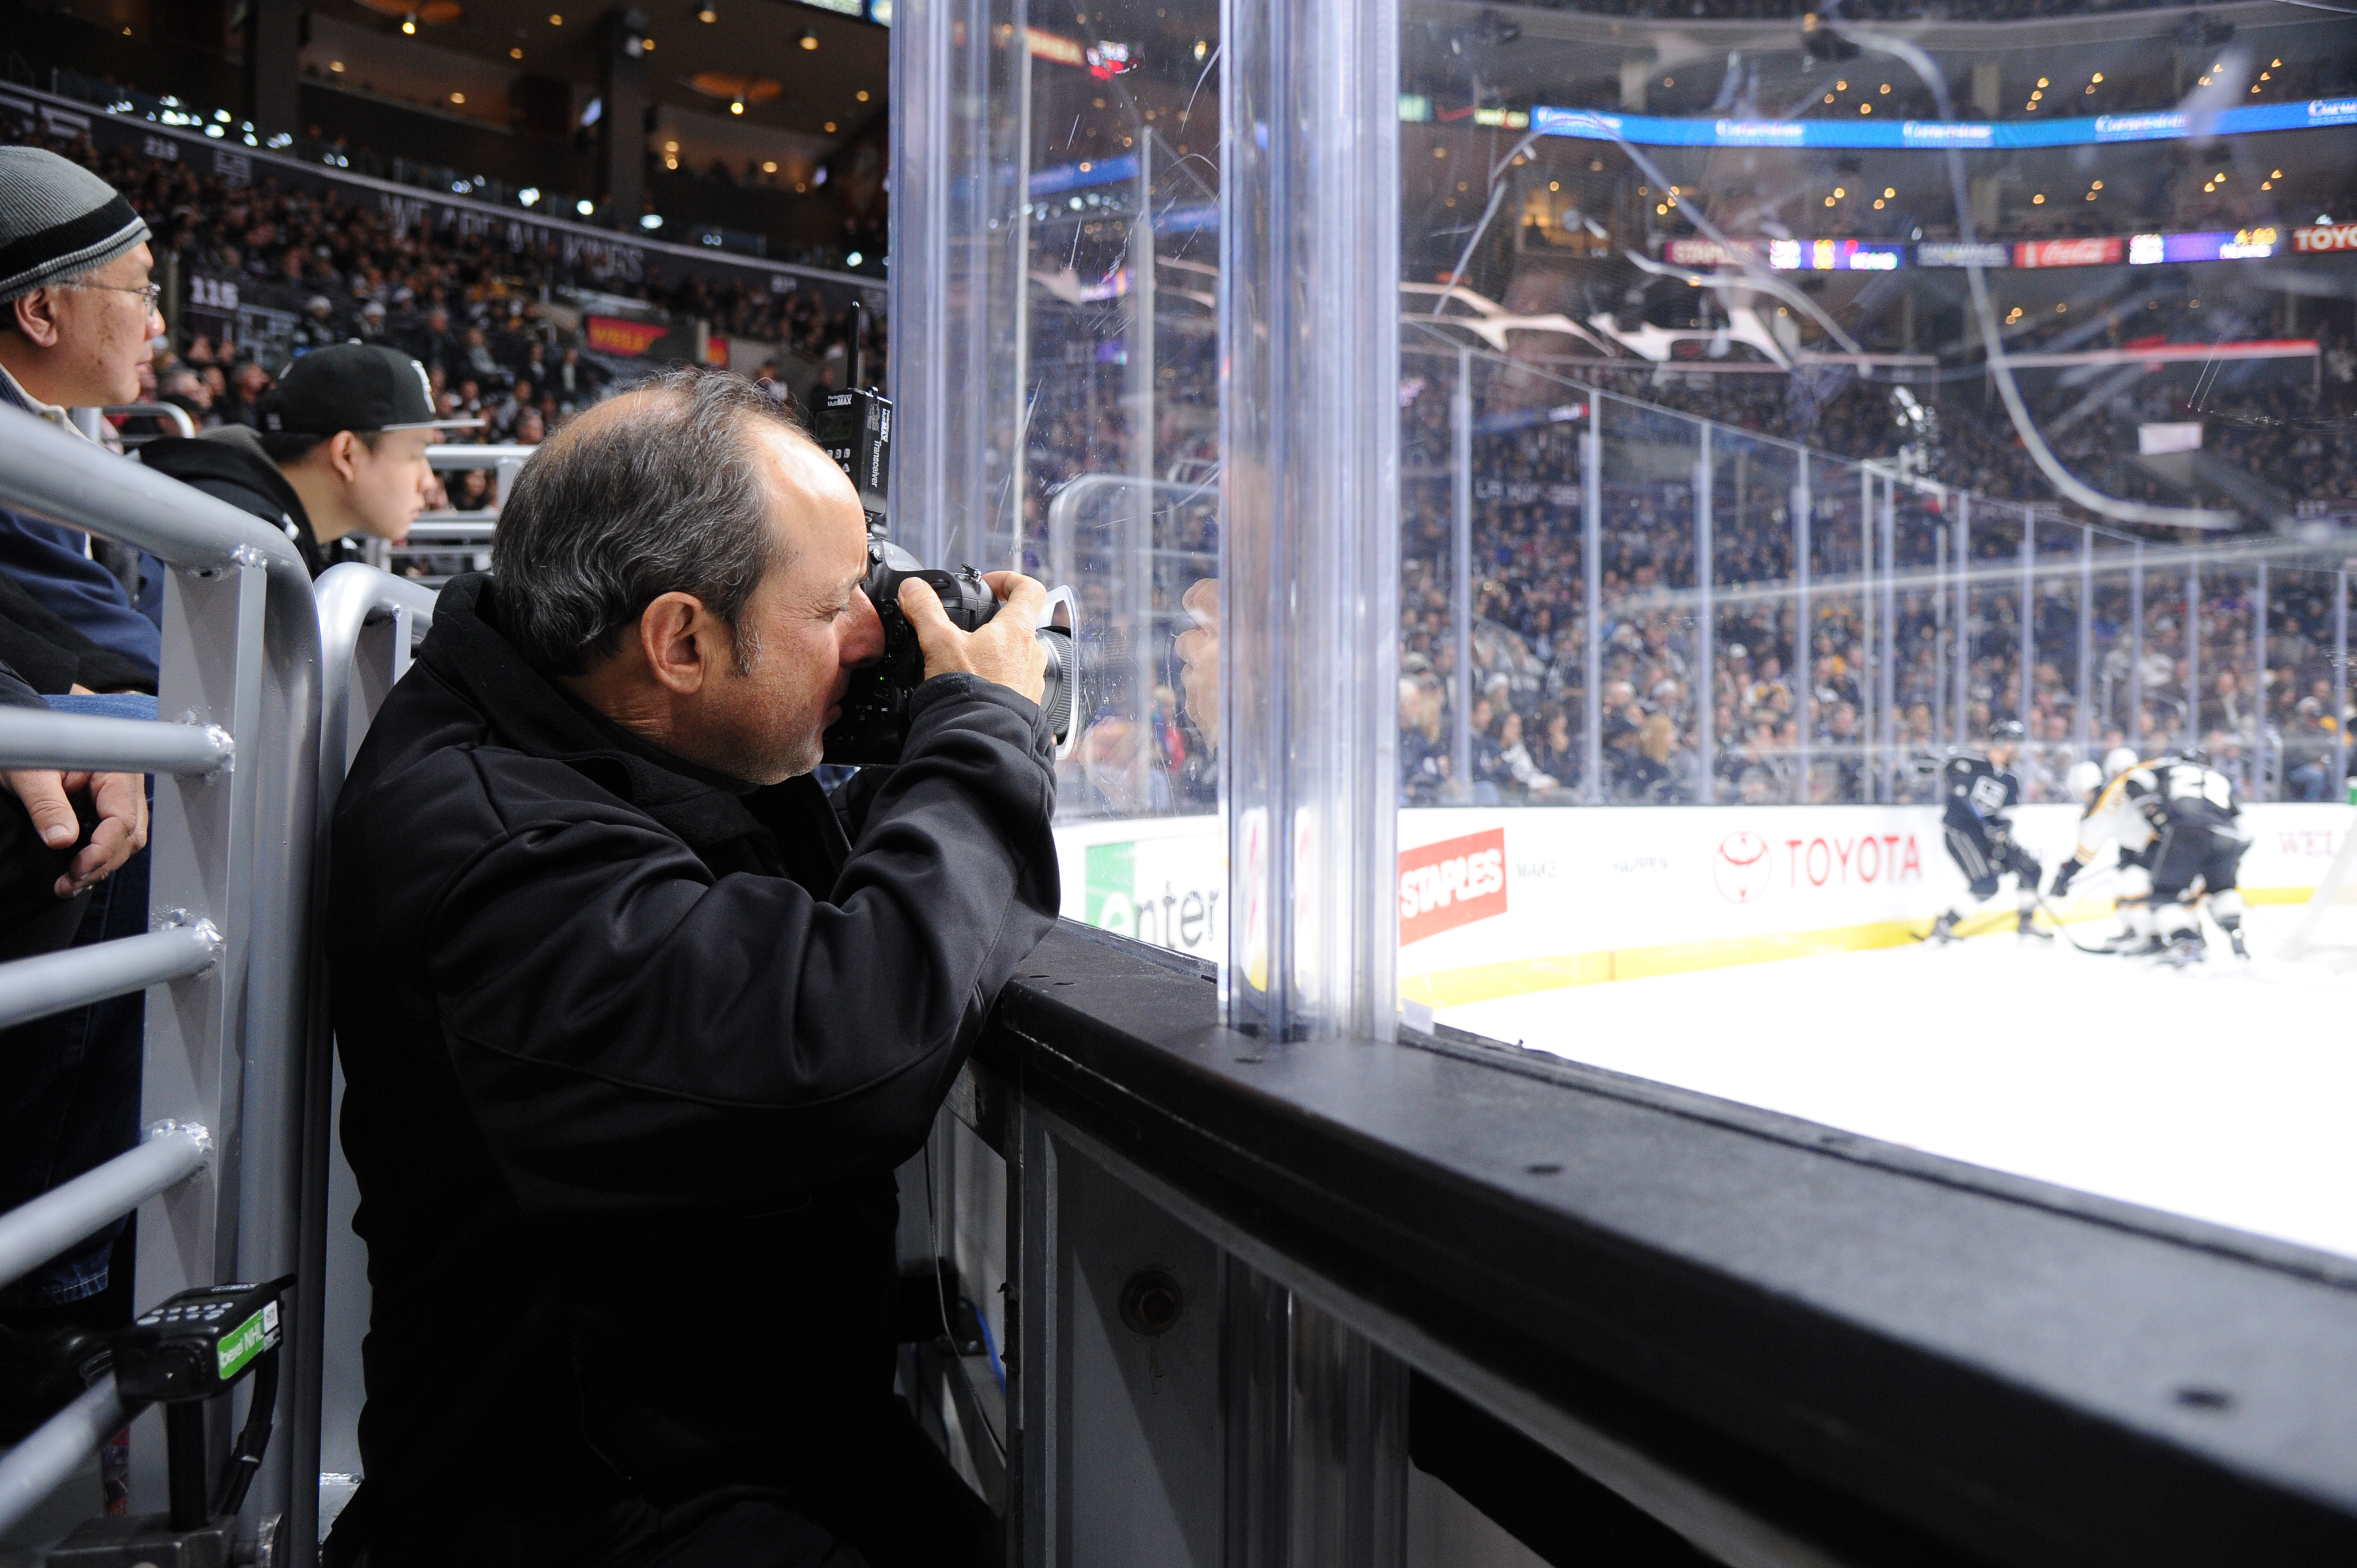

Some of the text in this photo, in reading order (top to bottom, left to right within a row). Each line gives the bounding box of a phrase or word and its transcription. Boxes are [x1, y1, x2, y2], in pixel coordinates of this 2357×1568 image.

[872, 440, 882, 487] Transceiver
[1400, 848, 1505, 920] STAPLES
[1784, 835, 1923, 888] TOYOTA
